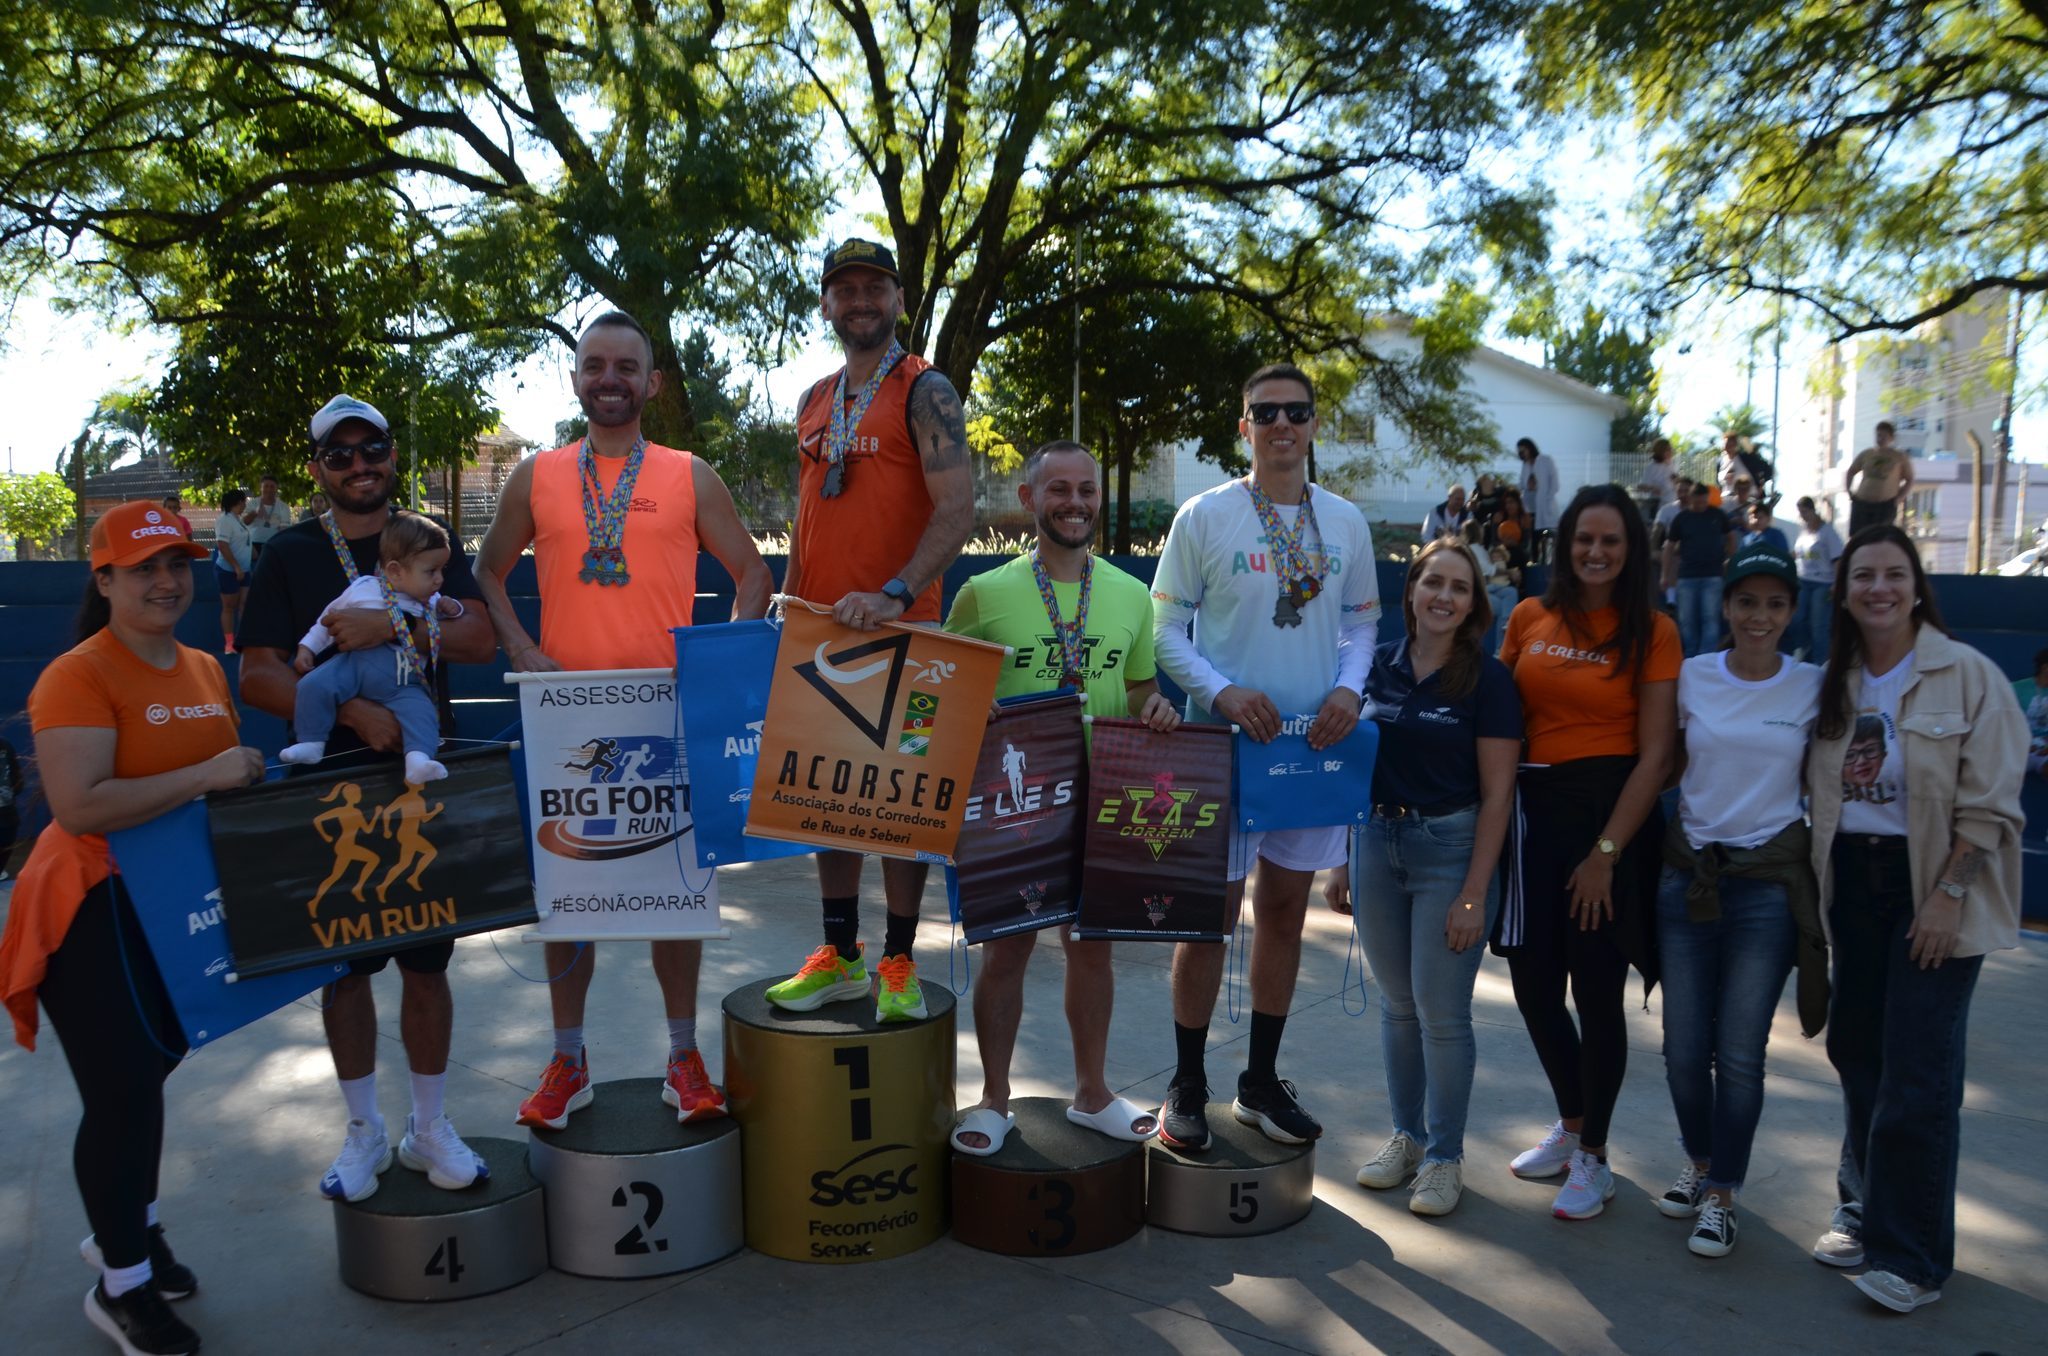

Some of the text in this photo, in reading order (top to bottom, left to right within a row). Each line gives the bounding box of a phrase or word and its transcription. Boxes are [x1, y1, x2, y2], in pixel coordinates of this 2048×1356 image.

[131, 525, 181, 540] CRESOL
[1546, 644, 1610, 664] CRESOL
[777, 750, 956, 813] ACORSEB
[540, 787, 599, 818] BIG
[771, 790, 947, 829] Associação dos Corredores
[964, 780, 1074, 822] ELES
[1096, 799, 1221, 828] ELAS
[627, 816, 671, 835] RUN
[801, 816, 912, 845] de Rua de Seberi
[1119, 825, 1196, 840] CORREM
[551, 894, 708, 913] #ÉSÓNÃOPARAR
[311, 897, 457, 948] VM RUN
[833, 1045, 872, 1142] 1
[809, 1157, 918, 1208] Sesc
[611, 1180, 669, 1255] 2
[1027, 1179, 1077, 1250] 3
[1228, 1181, 1259, 1224] 5
[808, 1209, 919, 1237] Fecomércio
[424, 1236, 465, 1283] 4
[810, 1240, 873, 1258] Senac
